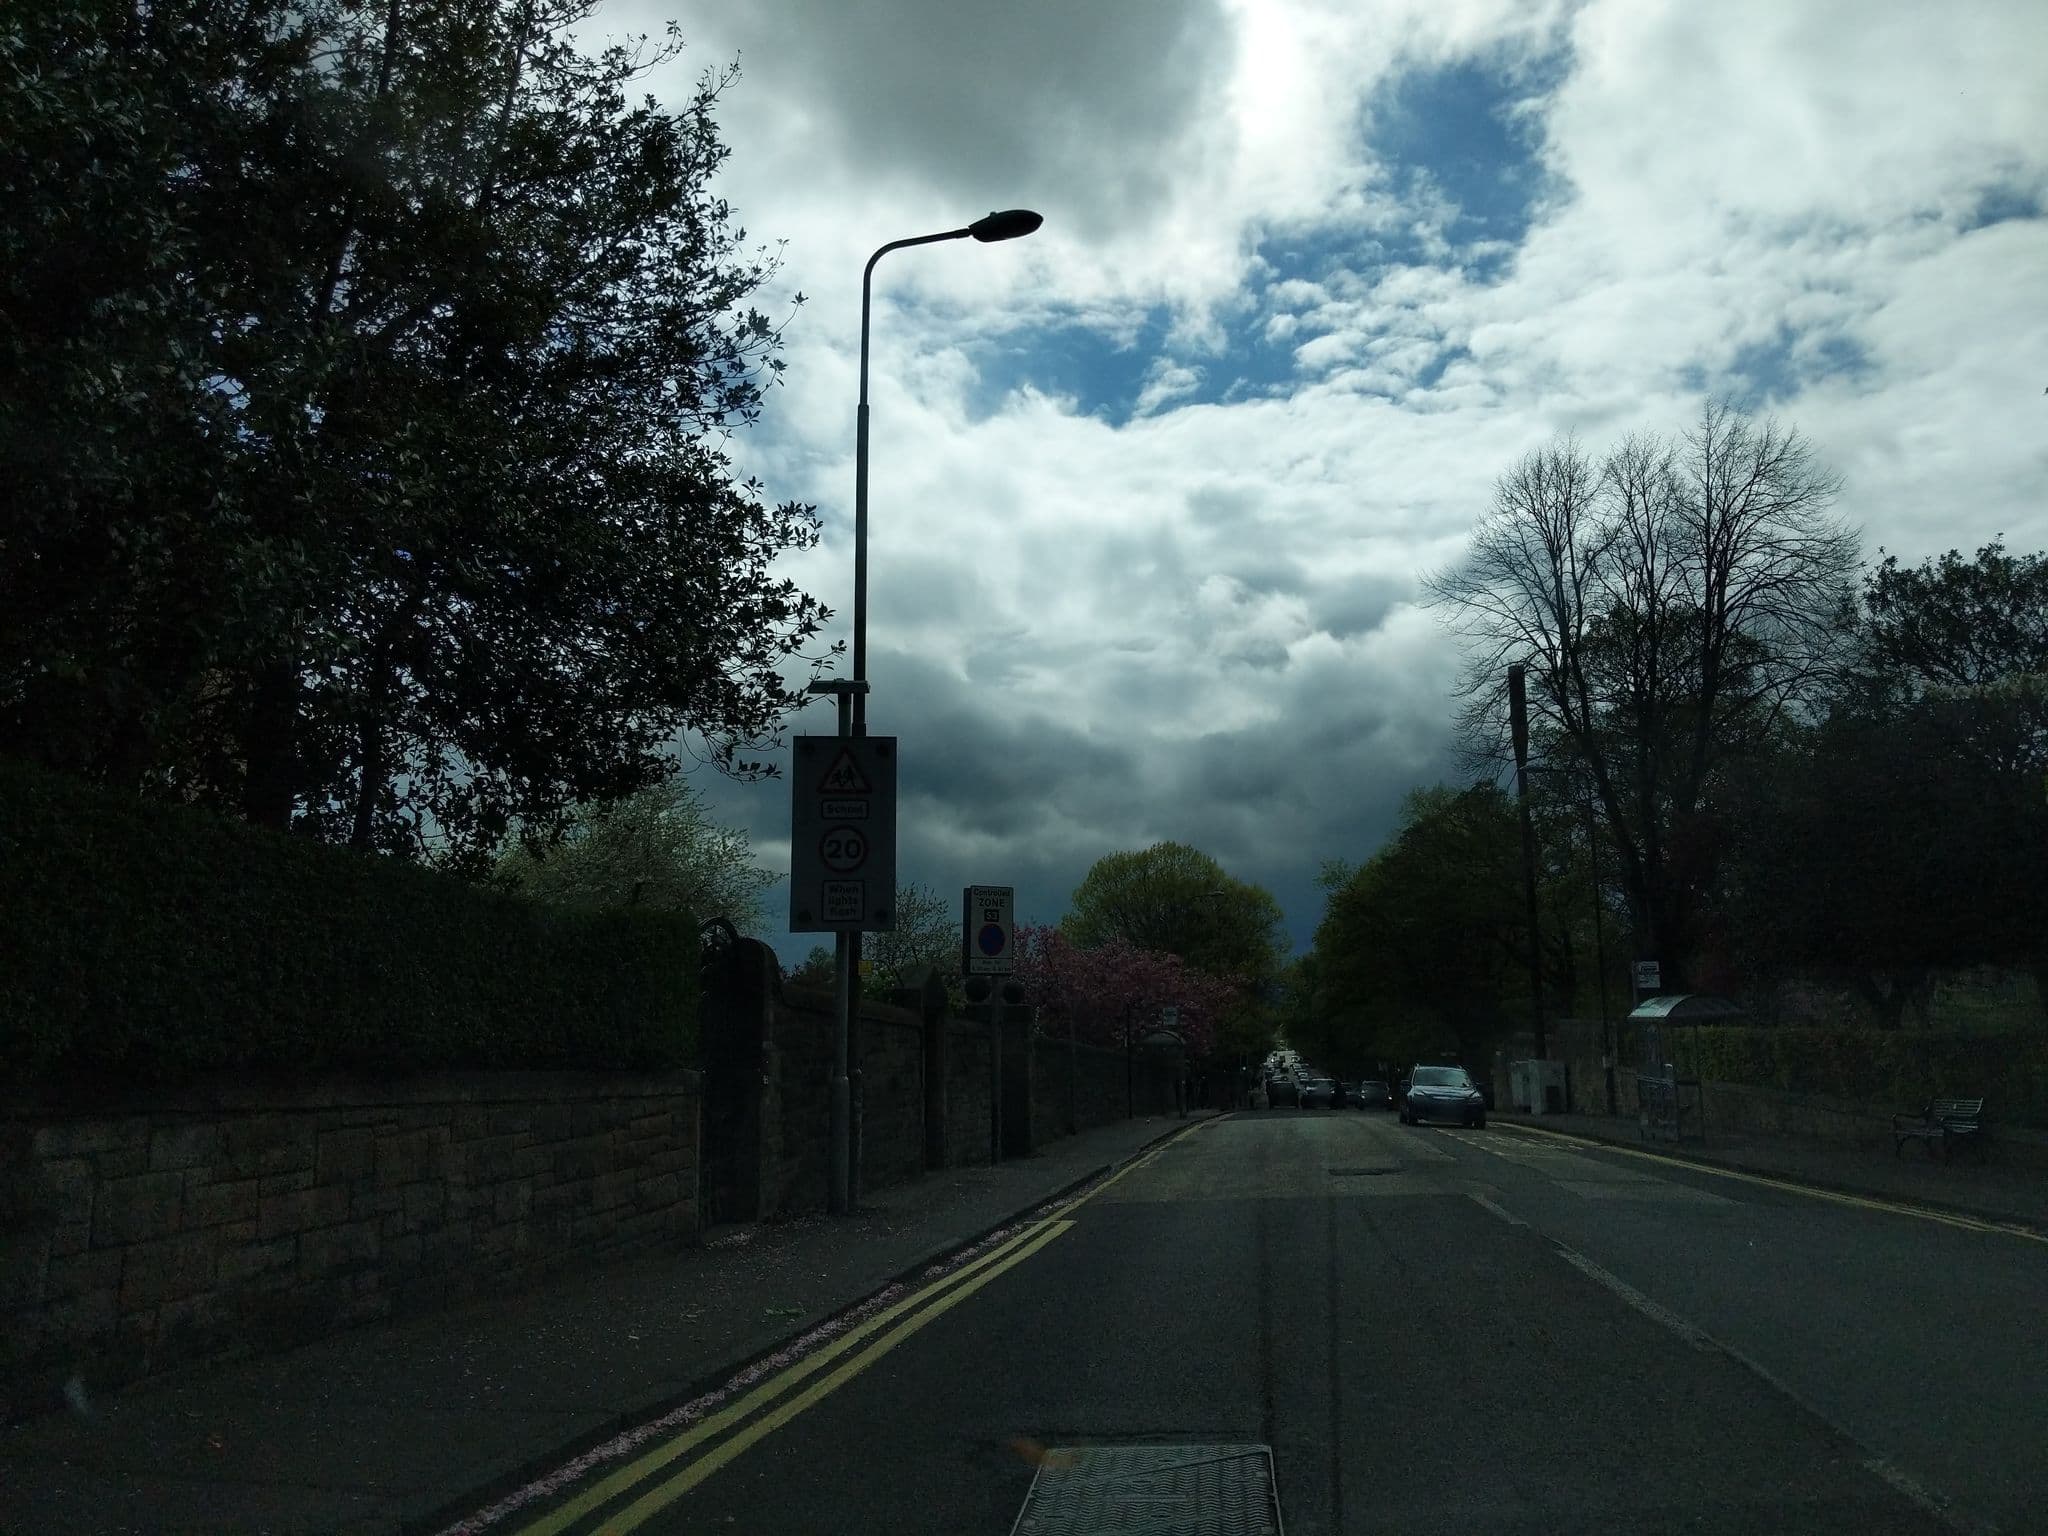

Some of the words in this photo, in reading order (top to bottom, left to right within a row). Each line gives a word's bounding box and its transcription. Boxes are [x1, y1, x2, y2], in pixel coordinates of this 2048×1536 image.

[827, 803, 863, 814] School
[828, 840, 860, 858] 20
[979, 898, 1005, 907] ZONE
